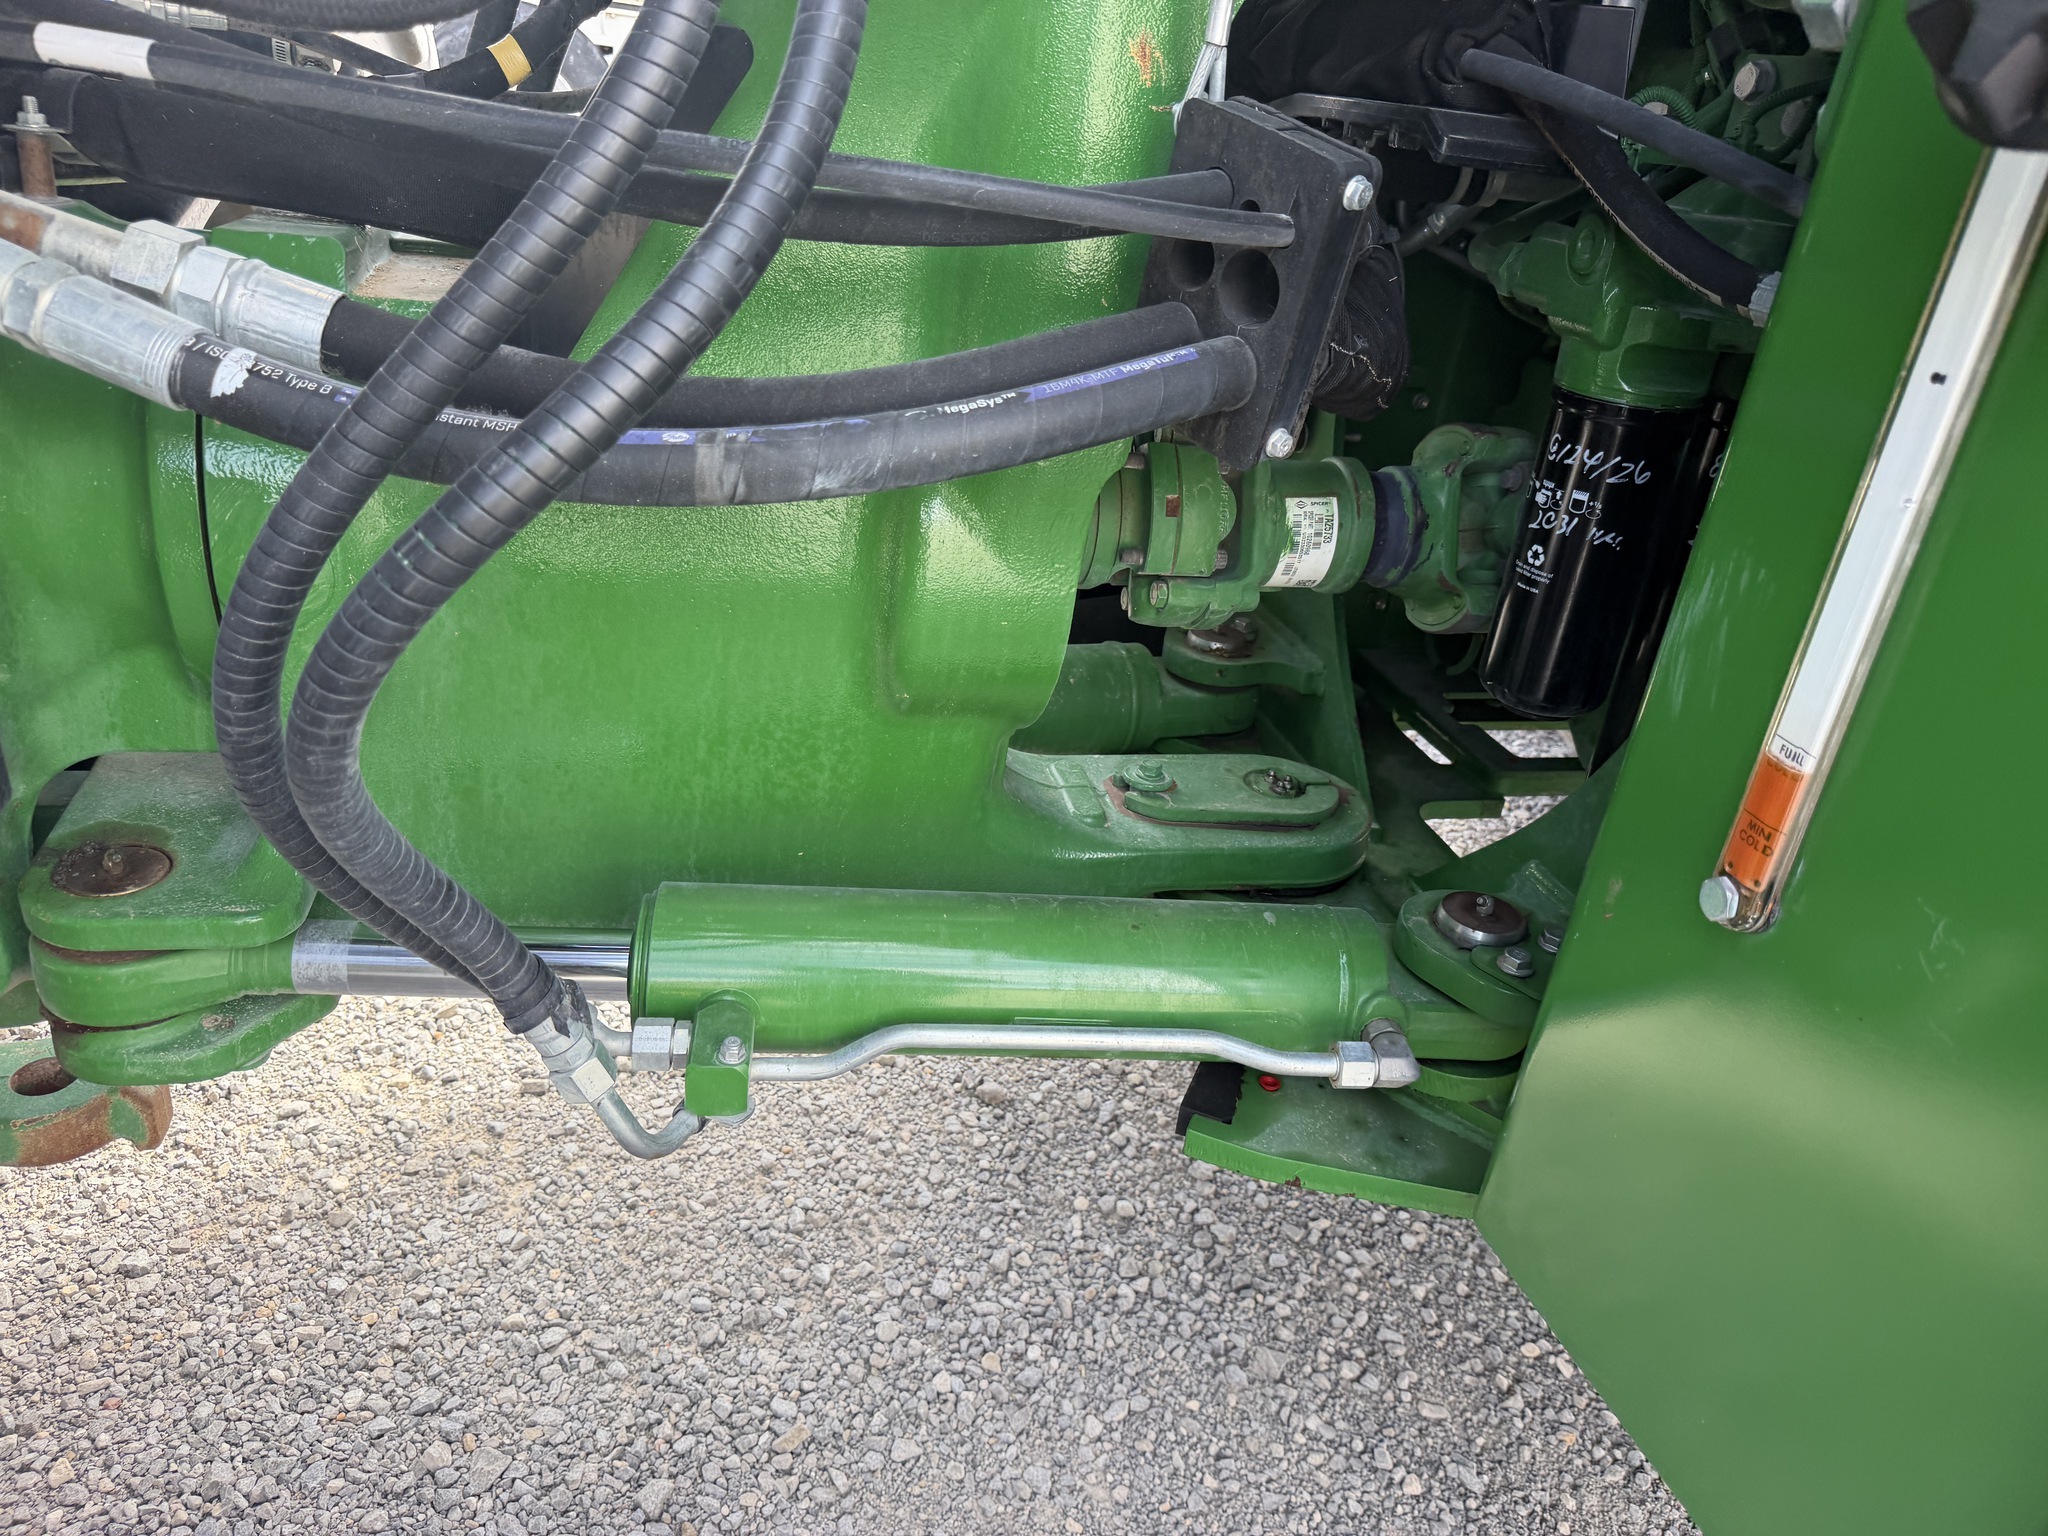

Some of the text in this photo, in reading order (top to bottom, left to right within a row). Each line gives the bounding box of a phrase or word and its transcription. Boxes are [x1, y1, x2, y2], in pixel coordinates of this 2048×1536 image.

[251, 361, 283, 379] 752
[285, 372, 318, 391] Type
[319, 384, 333, 395] B
[1740, 829, 1774, 856] COLD
[1748, 820, 1772, 842] MIN
